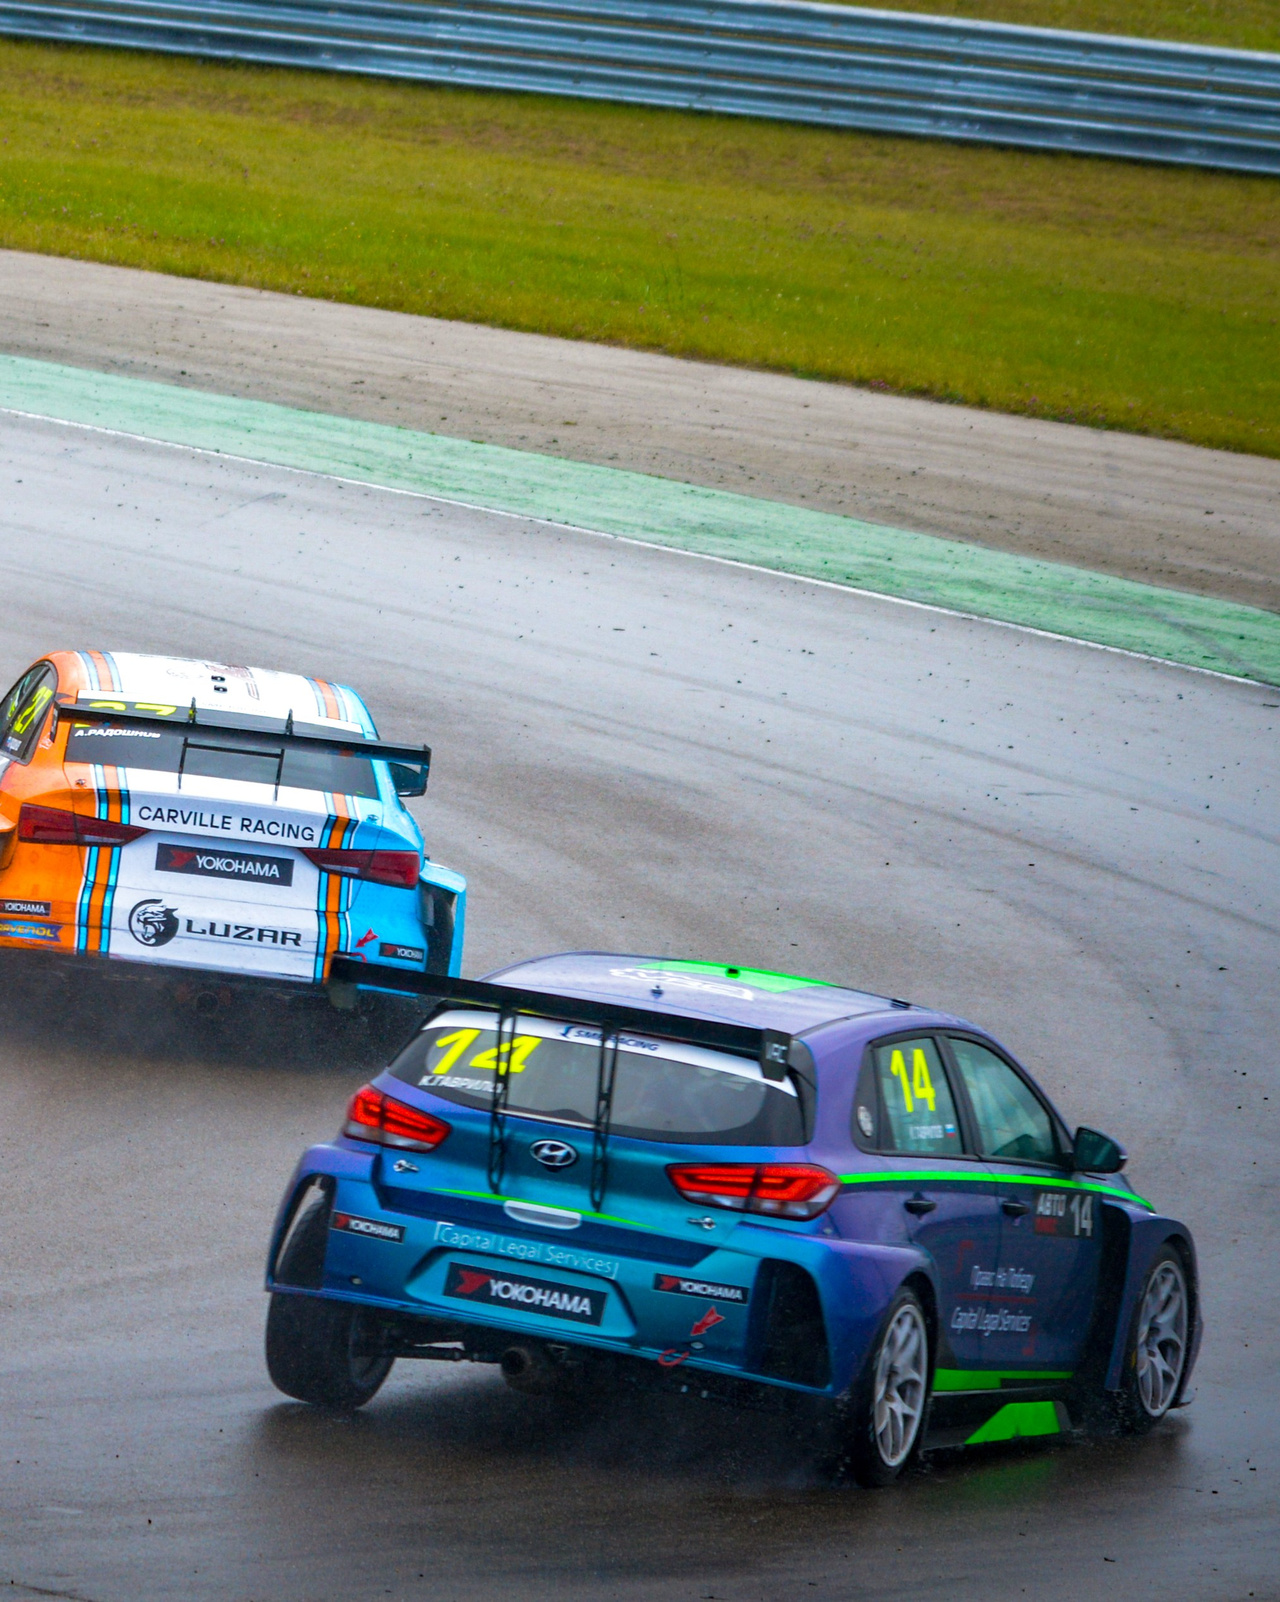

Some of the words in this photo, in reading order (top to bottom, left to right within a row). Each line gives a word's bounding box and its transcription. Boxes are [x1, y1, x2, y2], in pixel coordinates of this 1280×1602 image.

[14, 686, 53, 734] 27
[138, 806, 233, 830] CARVILLE
[240, 817, 316, 842] RACING
[196, 855, 280, 878] YOKOHAMA
[4, 901, 46, 914] YOKOHAMA
[186, 919, 302, 947] LUZAR
[436, 1028, 542, 1075] 14
[890, 1049, 936, 1112] 14
[1070, 1194, 1094, 1237] 14
[440, 1226, 496, 1249] Capital
[499, 1236, 543, 1260] Legal
[546, 1245, 612, 1273] Services
[489, 1279, 592, 1315] YOKOHAMA
[679, 1281, 743, 1300] YOKOHAMA
